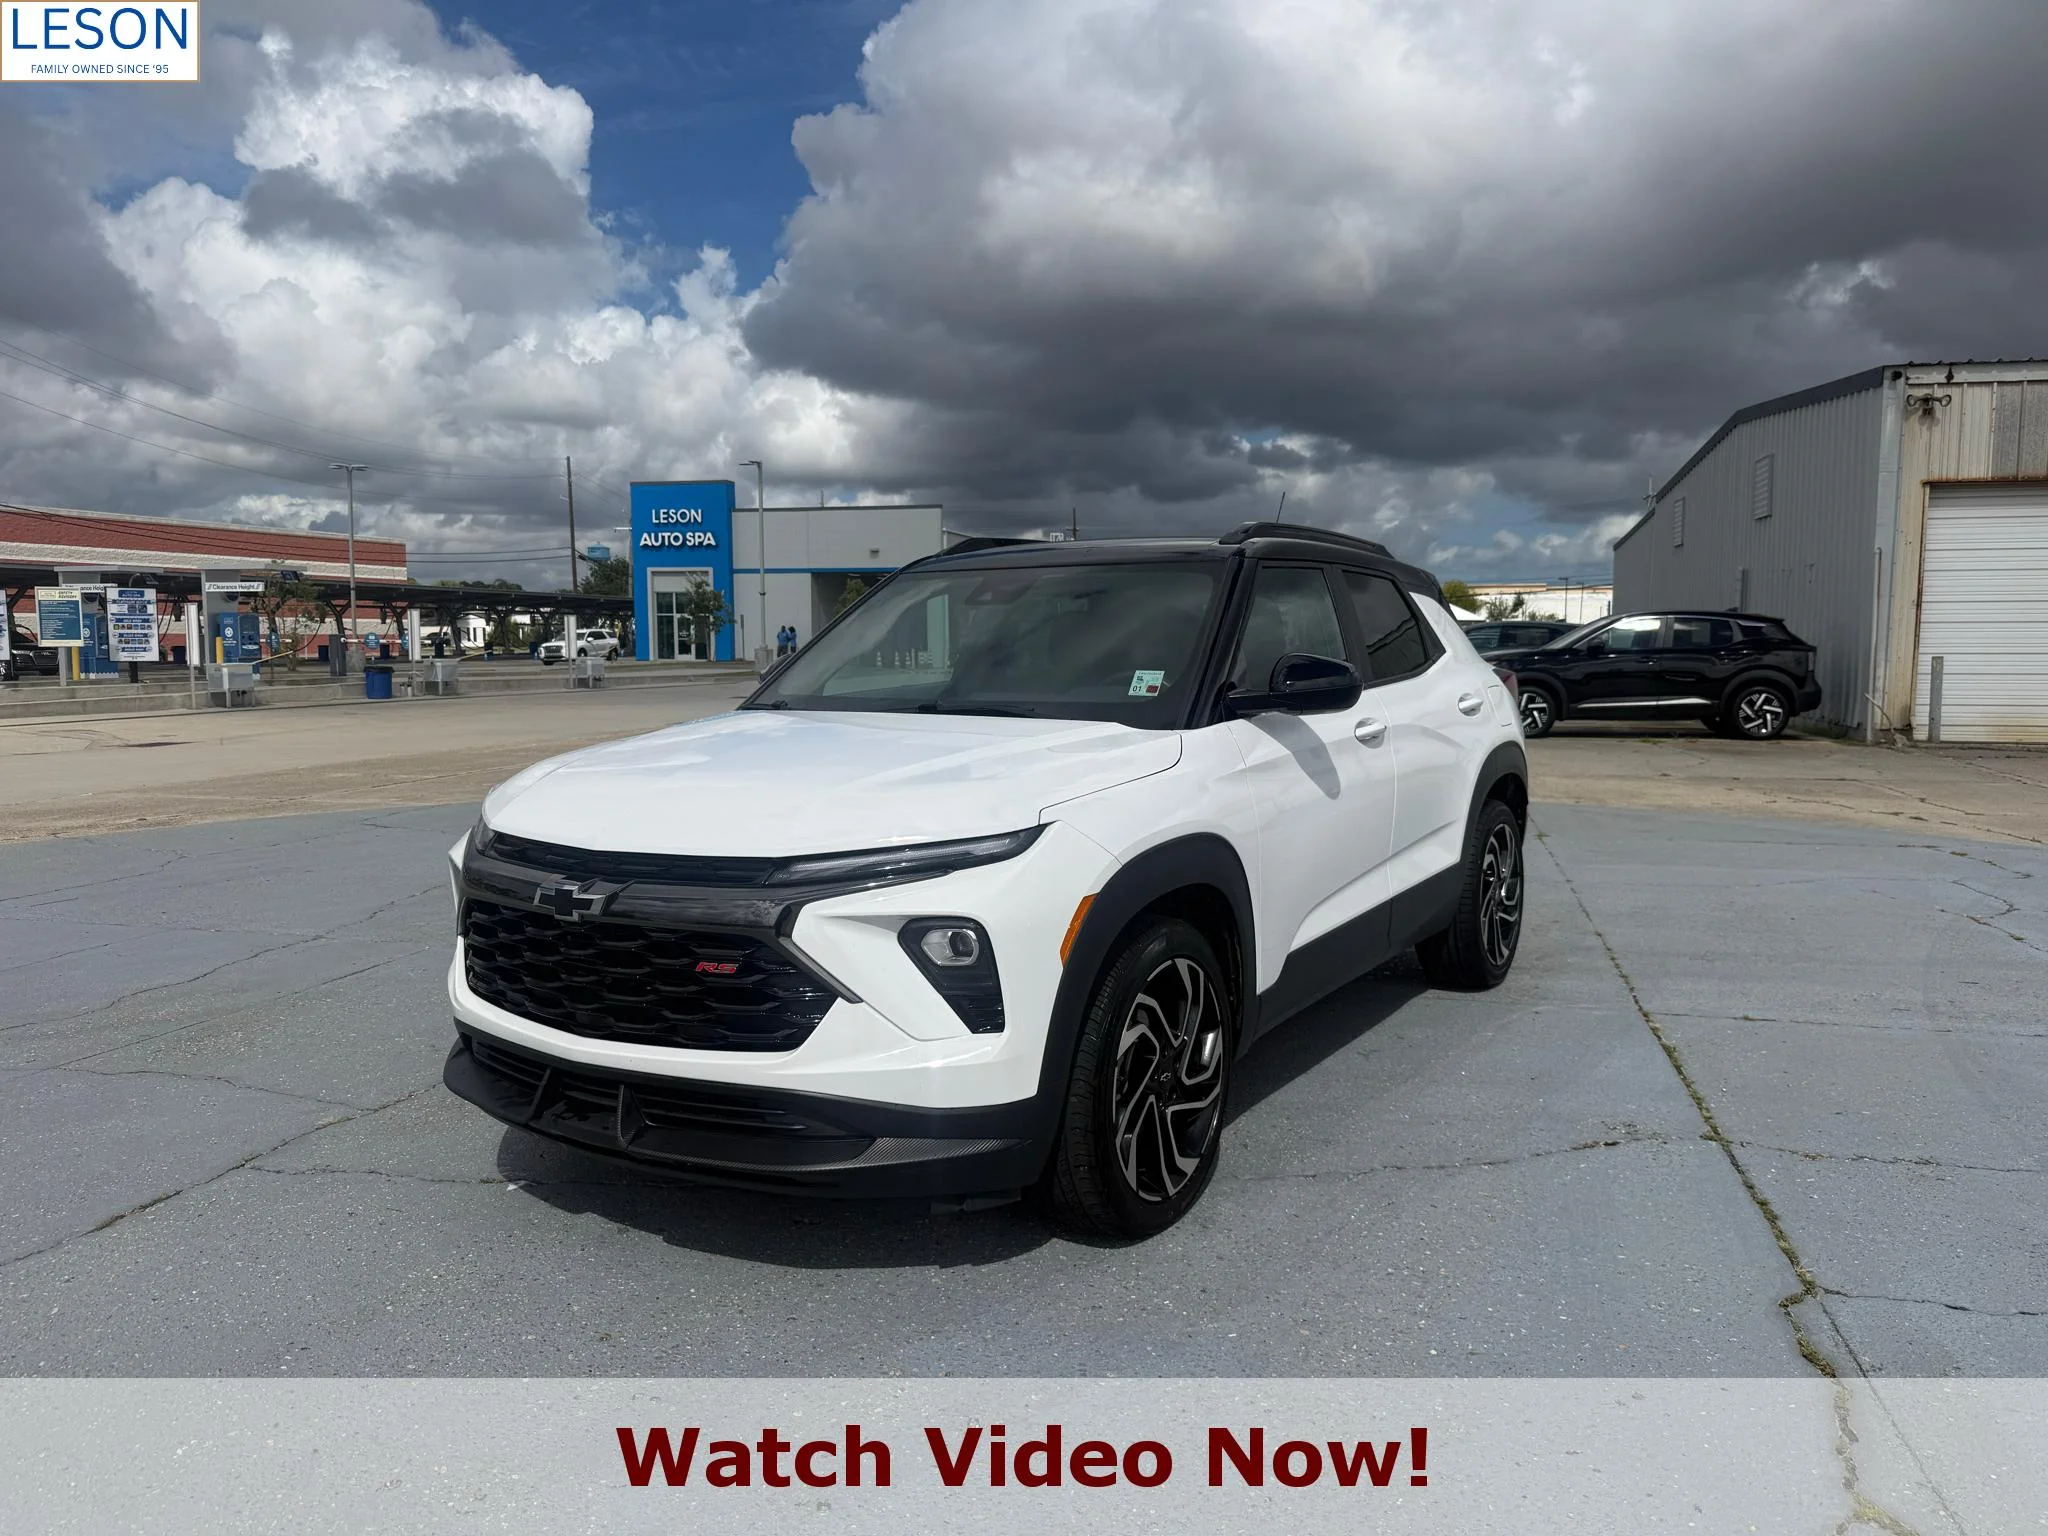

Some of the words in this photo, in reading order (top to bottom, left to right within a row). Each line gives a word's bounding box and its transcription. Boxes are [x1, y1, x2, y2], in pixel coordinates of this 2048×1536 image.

[652, 508, 702, 524] LESON
[640, 532, 683, 547] AUTO
[685, 531, 716, 546] SPA
[696, 961, 739, 974] RS
